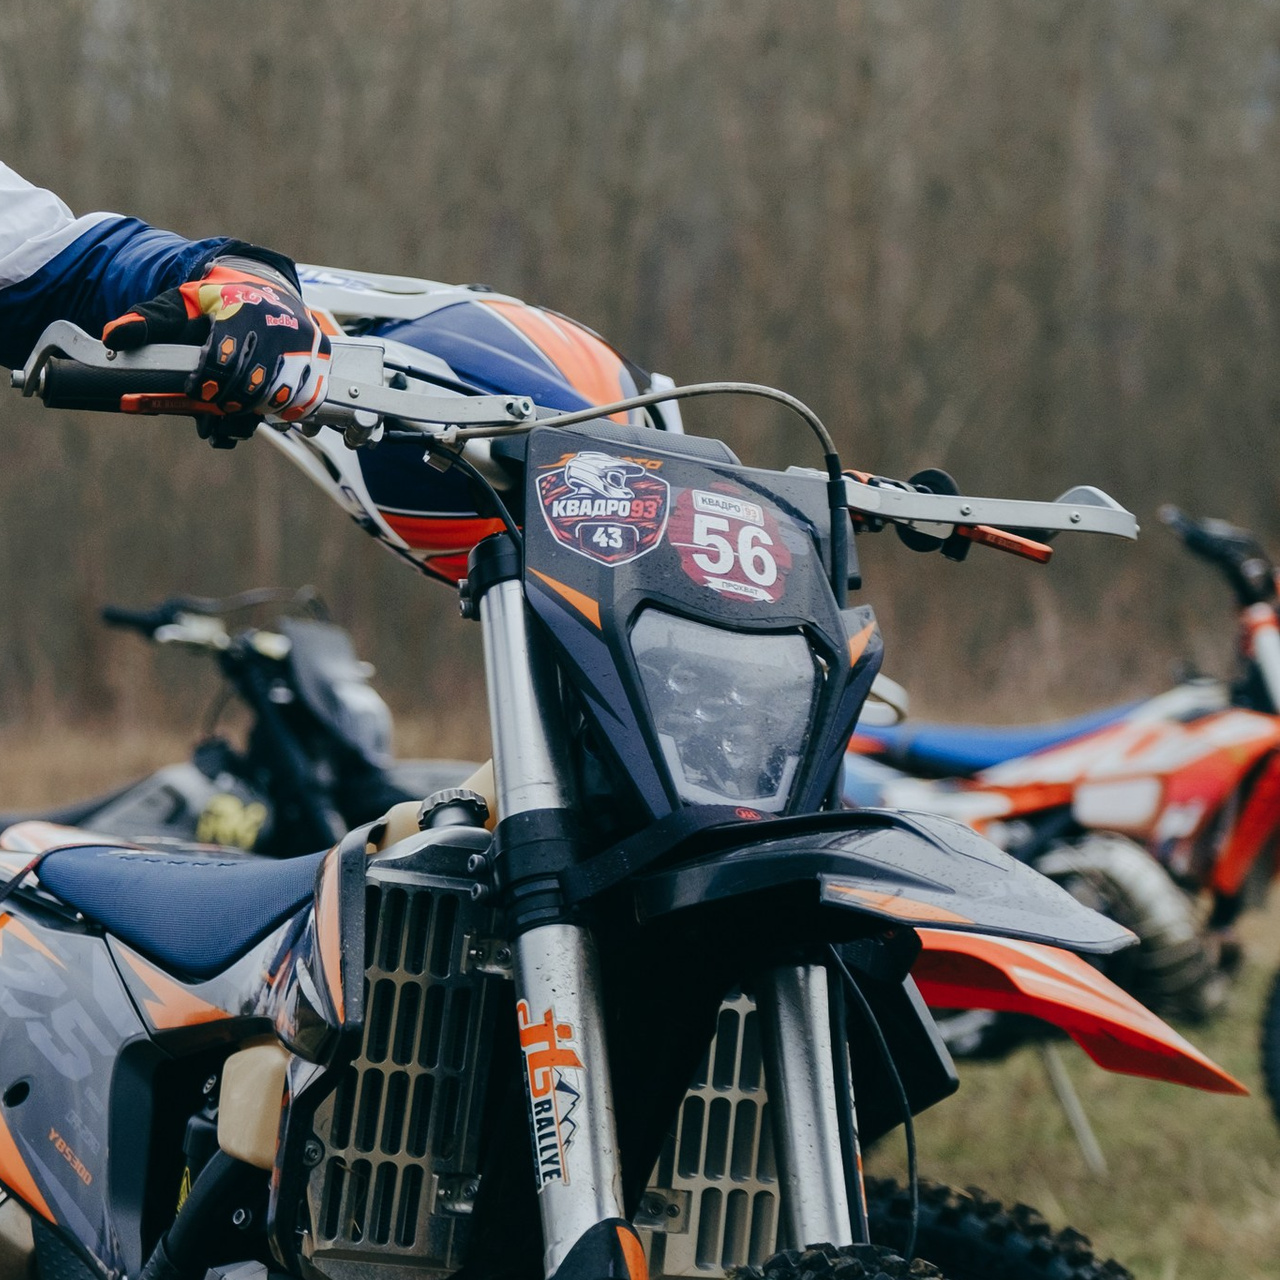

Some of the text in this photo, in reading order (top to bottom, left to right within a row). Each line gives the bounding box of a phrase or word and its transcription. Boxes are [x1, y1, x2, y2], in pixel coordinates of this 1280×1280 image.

[701, 496, 741, 513] КВАДРО
[592, 527, 623, 548] 43
[692, 513, 777, 587] 56
[534, 1098, 562, 1183] RALLYE
